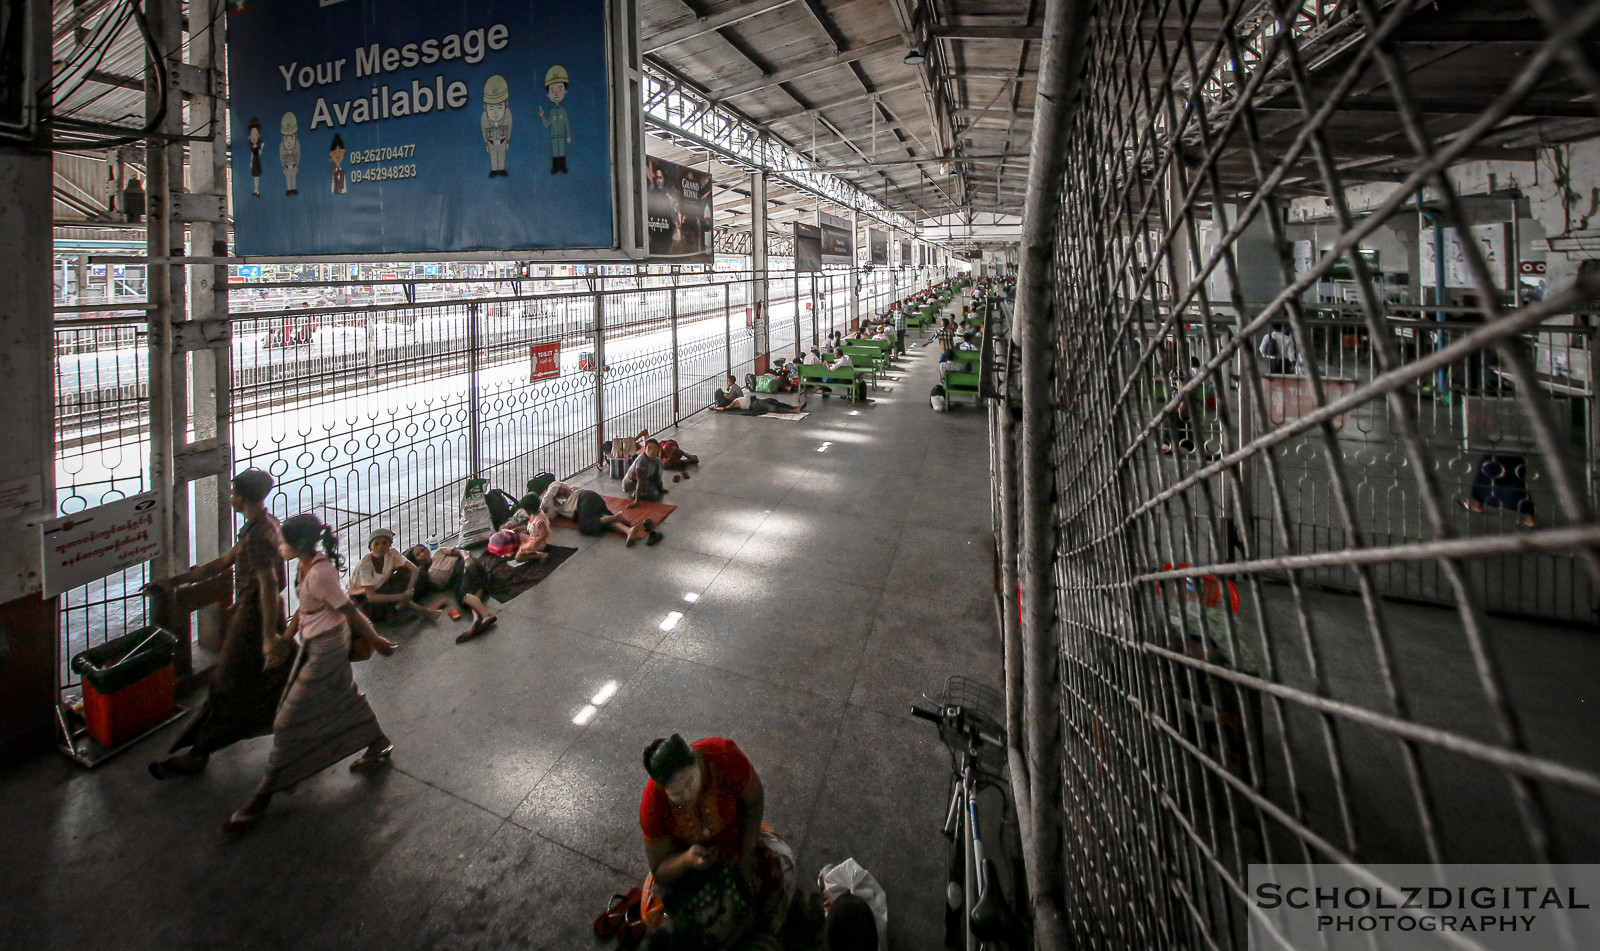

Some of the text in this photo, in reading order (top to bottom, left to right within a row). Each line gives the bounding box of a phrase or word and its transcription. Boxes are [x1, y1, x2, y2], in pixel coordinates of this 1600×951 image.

[279, 23, 509, 92] Your Message
[310, 75, 468, 130] Available
[350, 144, 416, 164] 09-262704477
[351, 164, 417, 183] 09-452948293
[682, 178, 700, 192] GRAND
[683, 188, 698, 200] ROYAL
